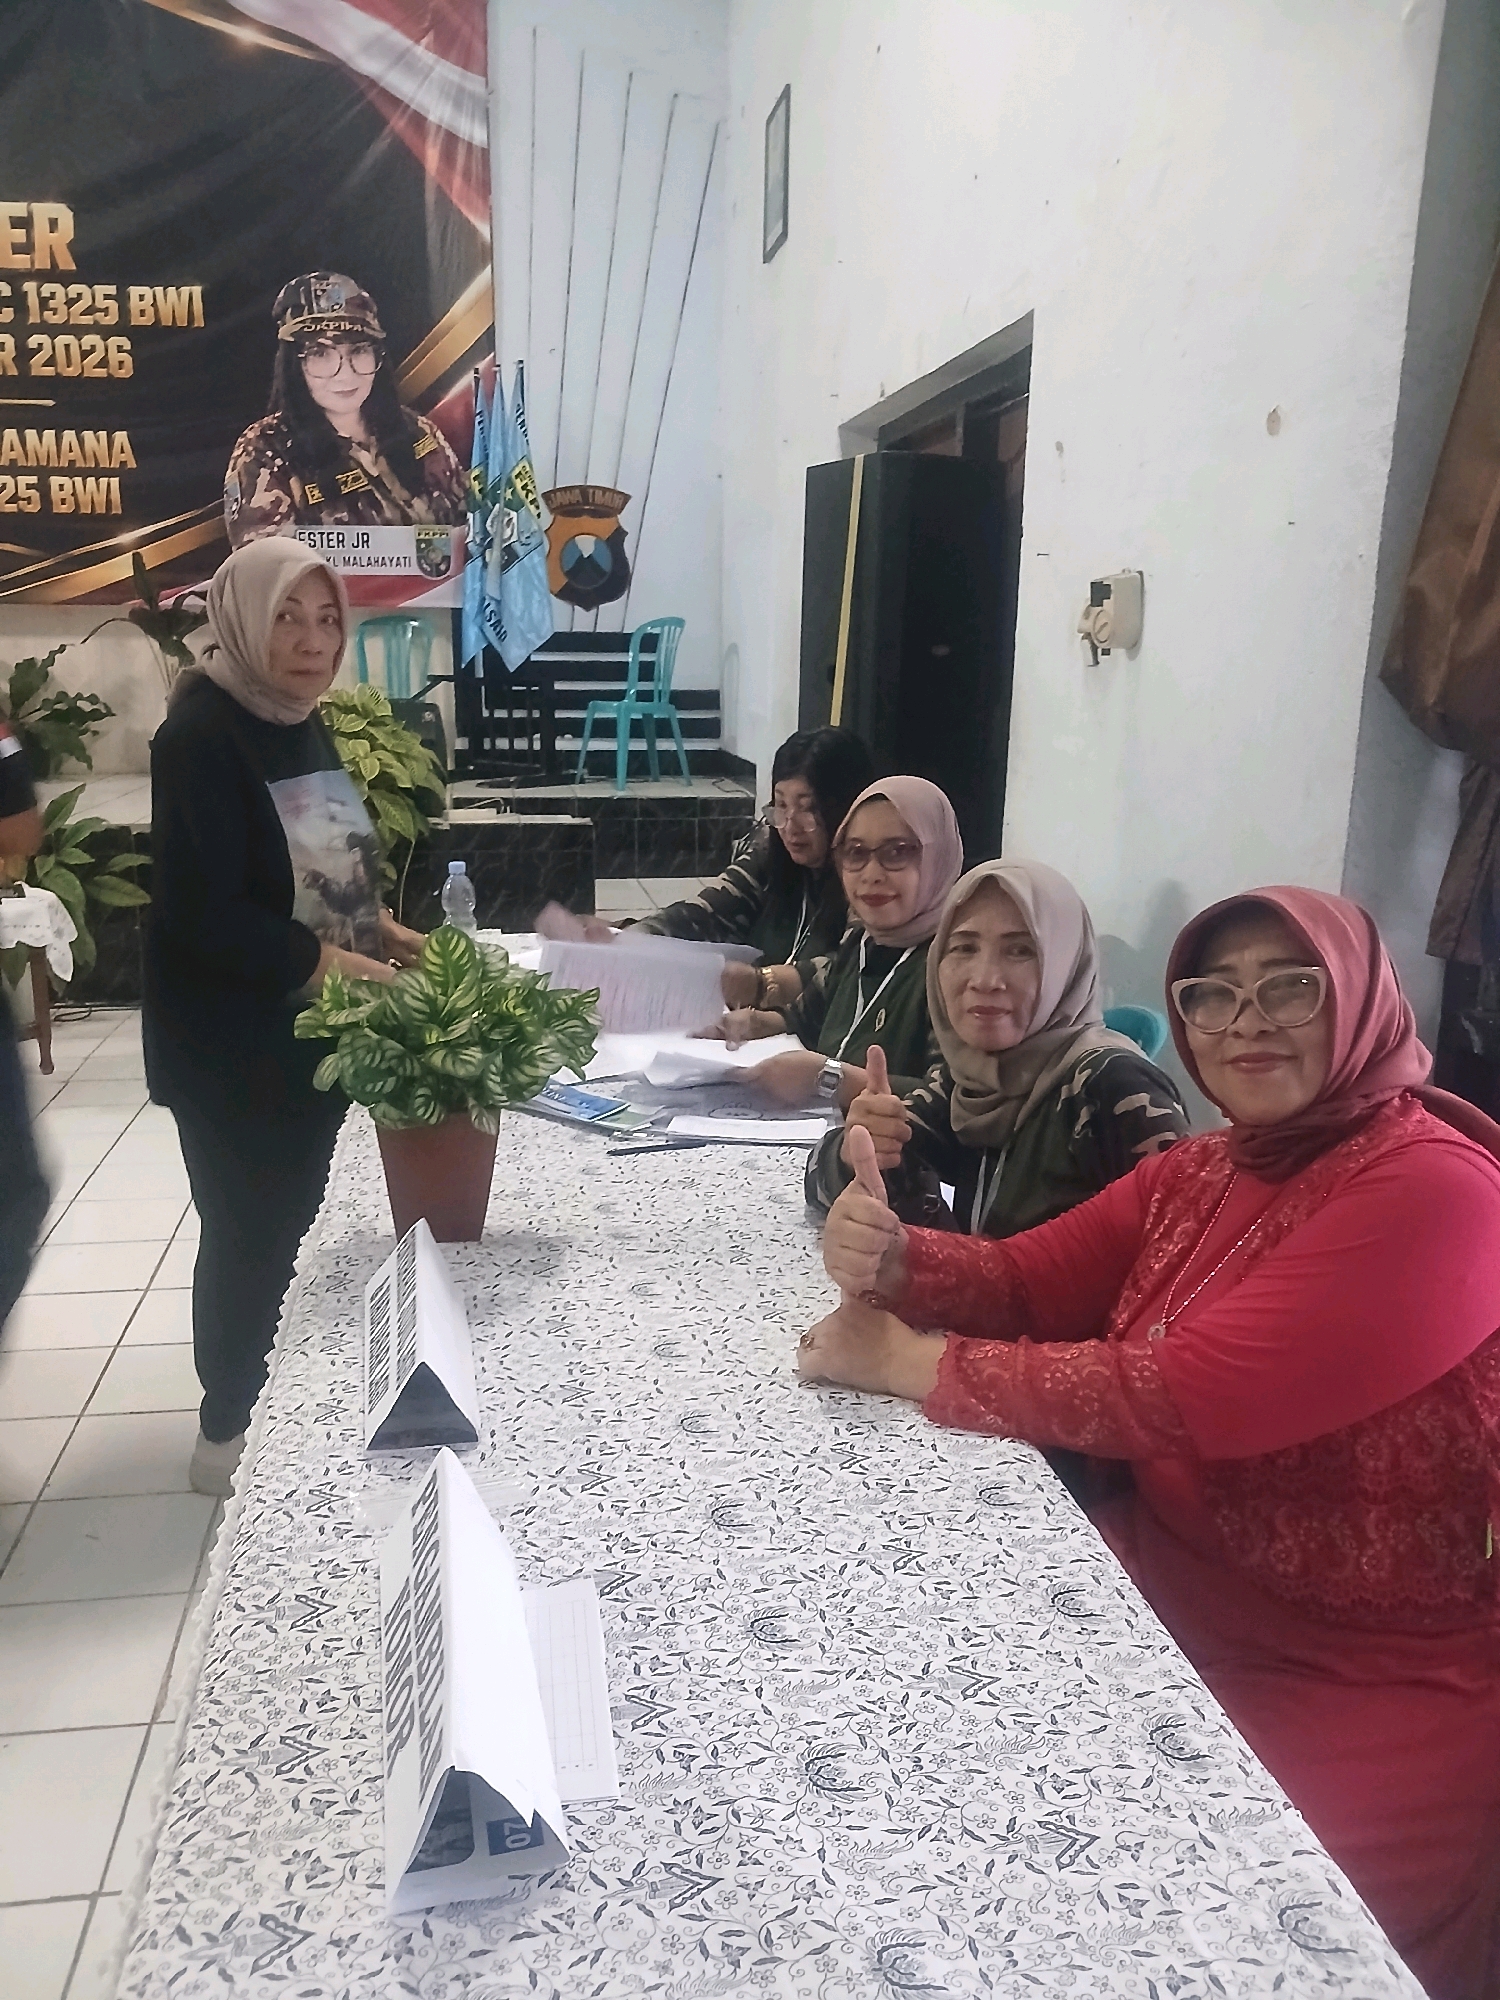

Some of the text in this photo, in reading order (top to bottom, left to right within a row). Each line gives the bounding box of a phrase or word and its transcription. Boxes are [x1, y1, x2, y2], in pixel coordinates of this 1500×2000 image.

[0, 202, 76, 270] ER
[23, 281, 119, 325] 1325
[127, 285, 204, 327] BWI
[28, 334, 133, 378] 2026
[0, 428, 137, 468] AMANA
[49, 476, 122, 514] BWI
[343, 556, 412, 568] MALAHAYATI
[352, 532, 370, 549] JR
[369, 1284, 390, 1335] NADA
[369, 1315, 390, 1378] DASAR
[396, 1332, 416, 1391] LAGU
[368, 1356, 389, 1414] LAGU
[411, 1469, 445, 1813] PENGAMBILAN
[385, 1577, 415, 1781] NOMOR
